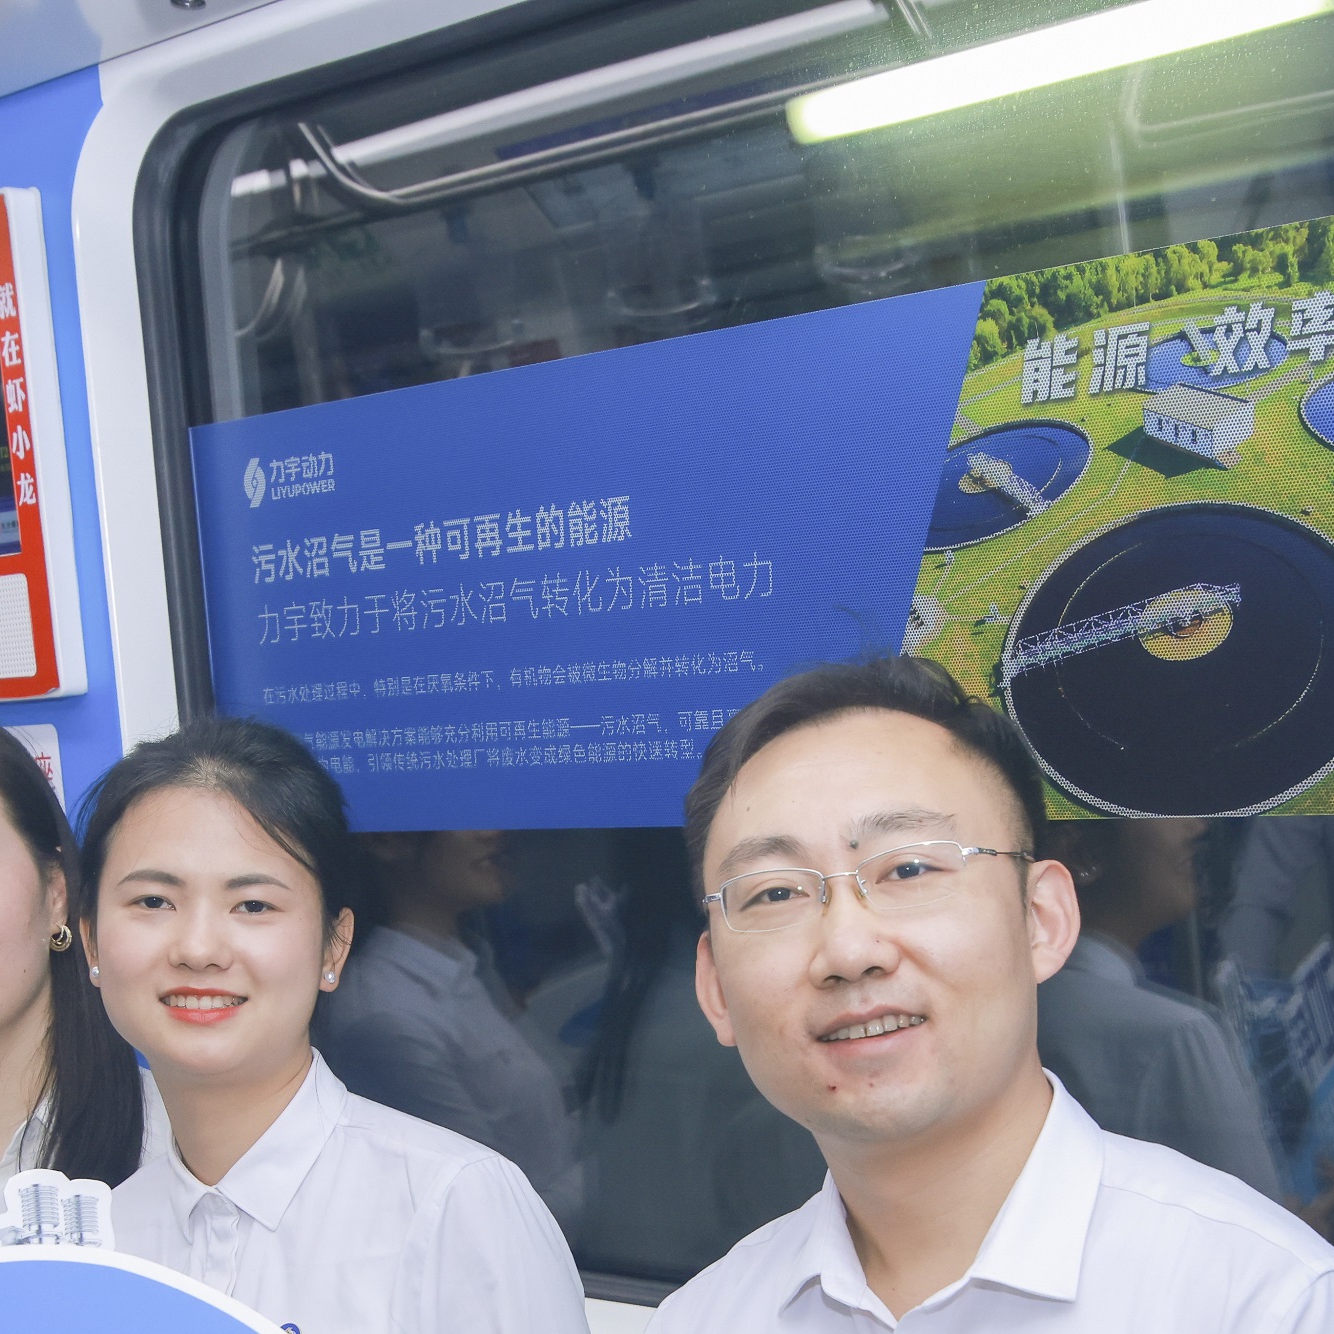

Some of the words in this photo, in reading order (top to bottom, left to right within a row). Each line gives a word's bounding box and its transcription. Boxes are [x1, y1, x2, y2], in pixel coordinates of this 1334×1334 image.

[1020, 321, 1151, 404] 能源
[269, 451, 335, 484] 力宇动力
[270, 478, 336, 501] LIYUPOWER
[251, 494, 634, 585] 污水沼气是一种可再生的能源
[257, 551, 775, 646] 力宇致力于将污水沼气转化为清洁电力
